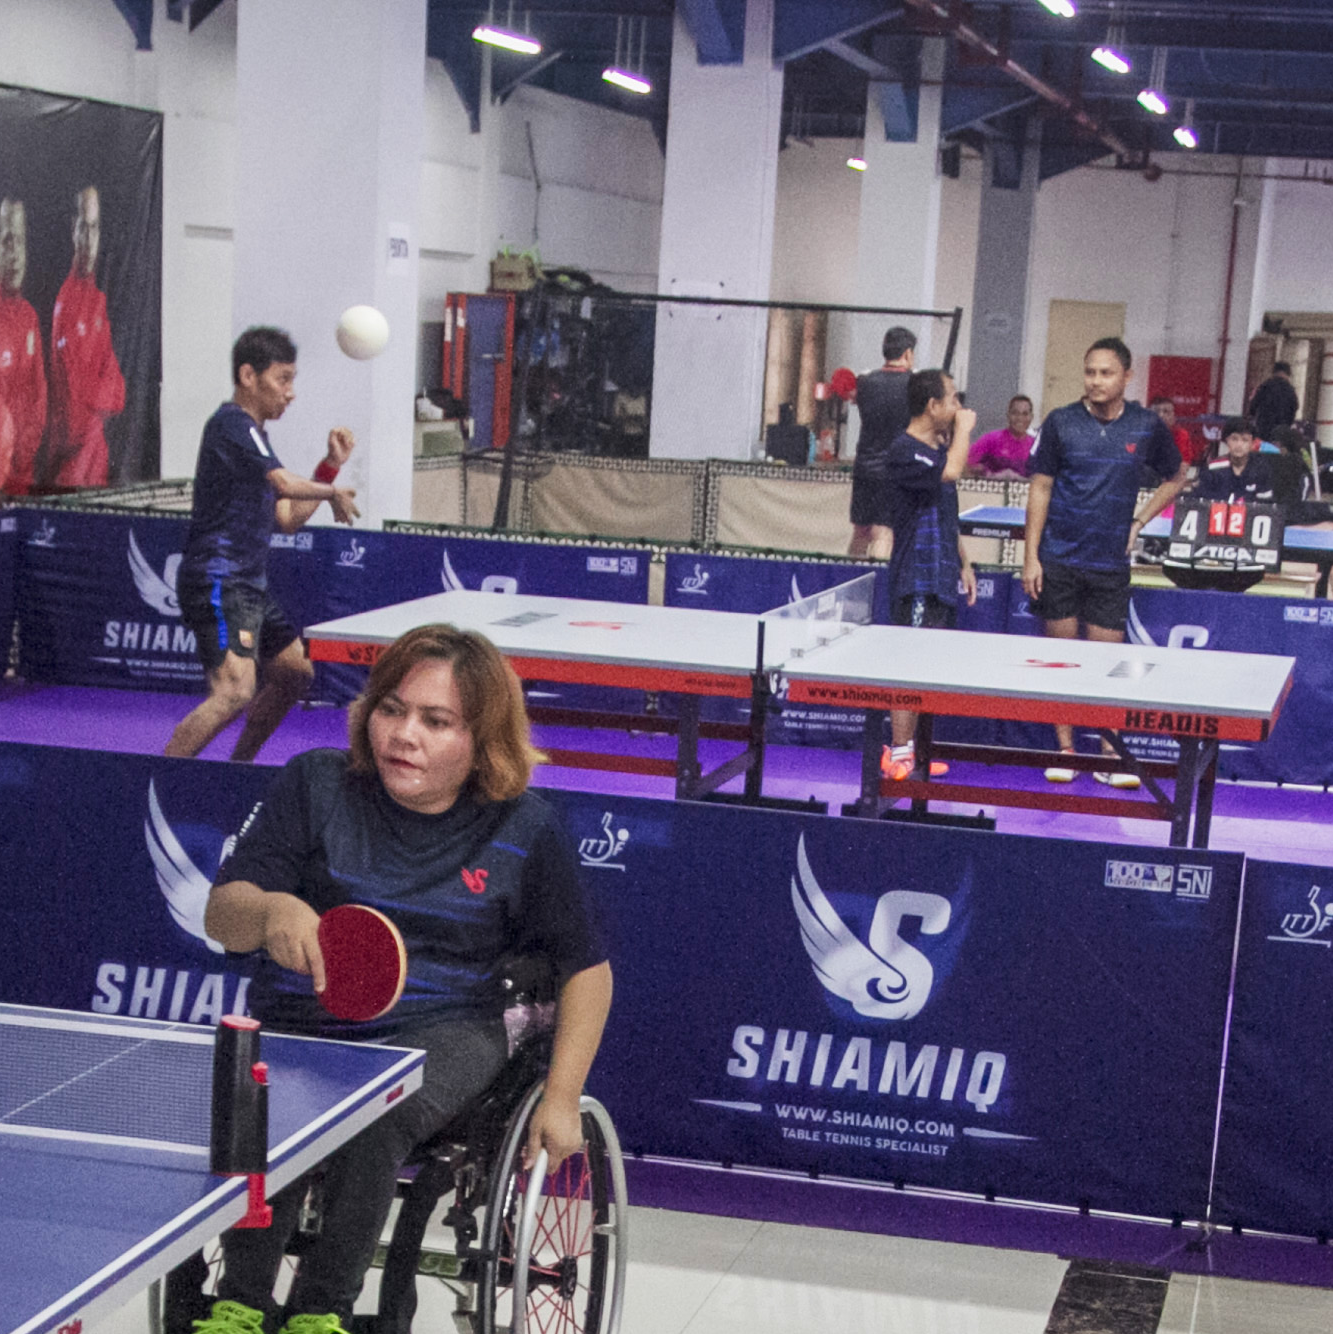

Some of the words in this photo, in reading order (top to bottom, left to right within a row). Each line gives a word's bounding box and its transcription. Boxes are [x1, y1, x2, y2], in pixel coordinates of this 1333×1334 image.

[1179, 510, 1199, 540] 4
[1214, 511, 1223, 533] 1
[1229, 512, 1243, 534] 2
[1251, 515, 1272, 545] 0
[807, 684, 924, 707] www.shiamiq.com
[1124, 709, 1219, 736] HEADIS
[578, 838, 626, 857] ITTF
[1176, 866, 1213, 897] SNI
[1281, 913, 1333, 932] ITTF
[726, 1024, 1007, 1113] SHIAMIQ
[774, 1103, 956, 1138] WWW.SHIAMIQ.COM
[781, 1127, 820, 1143] TABLE
[824, 1131, 872, 1148] TENNIS
[874, 1136, 949, 1157] SPECIALIST
